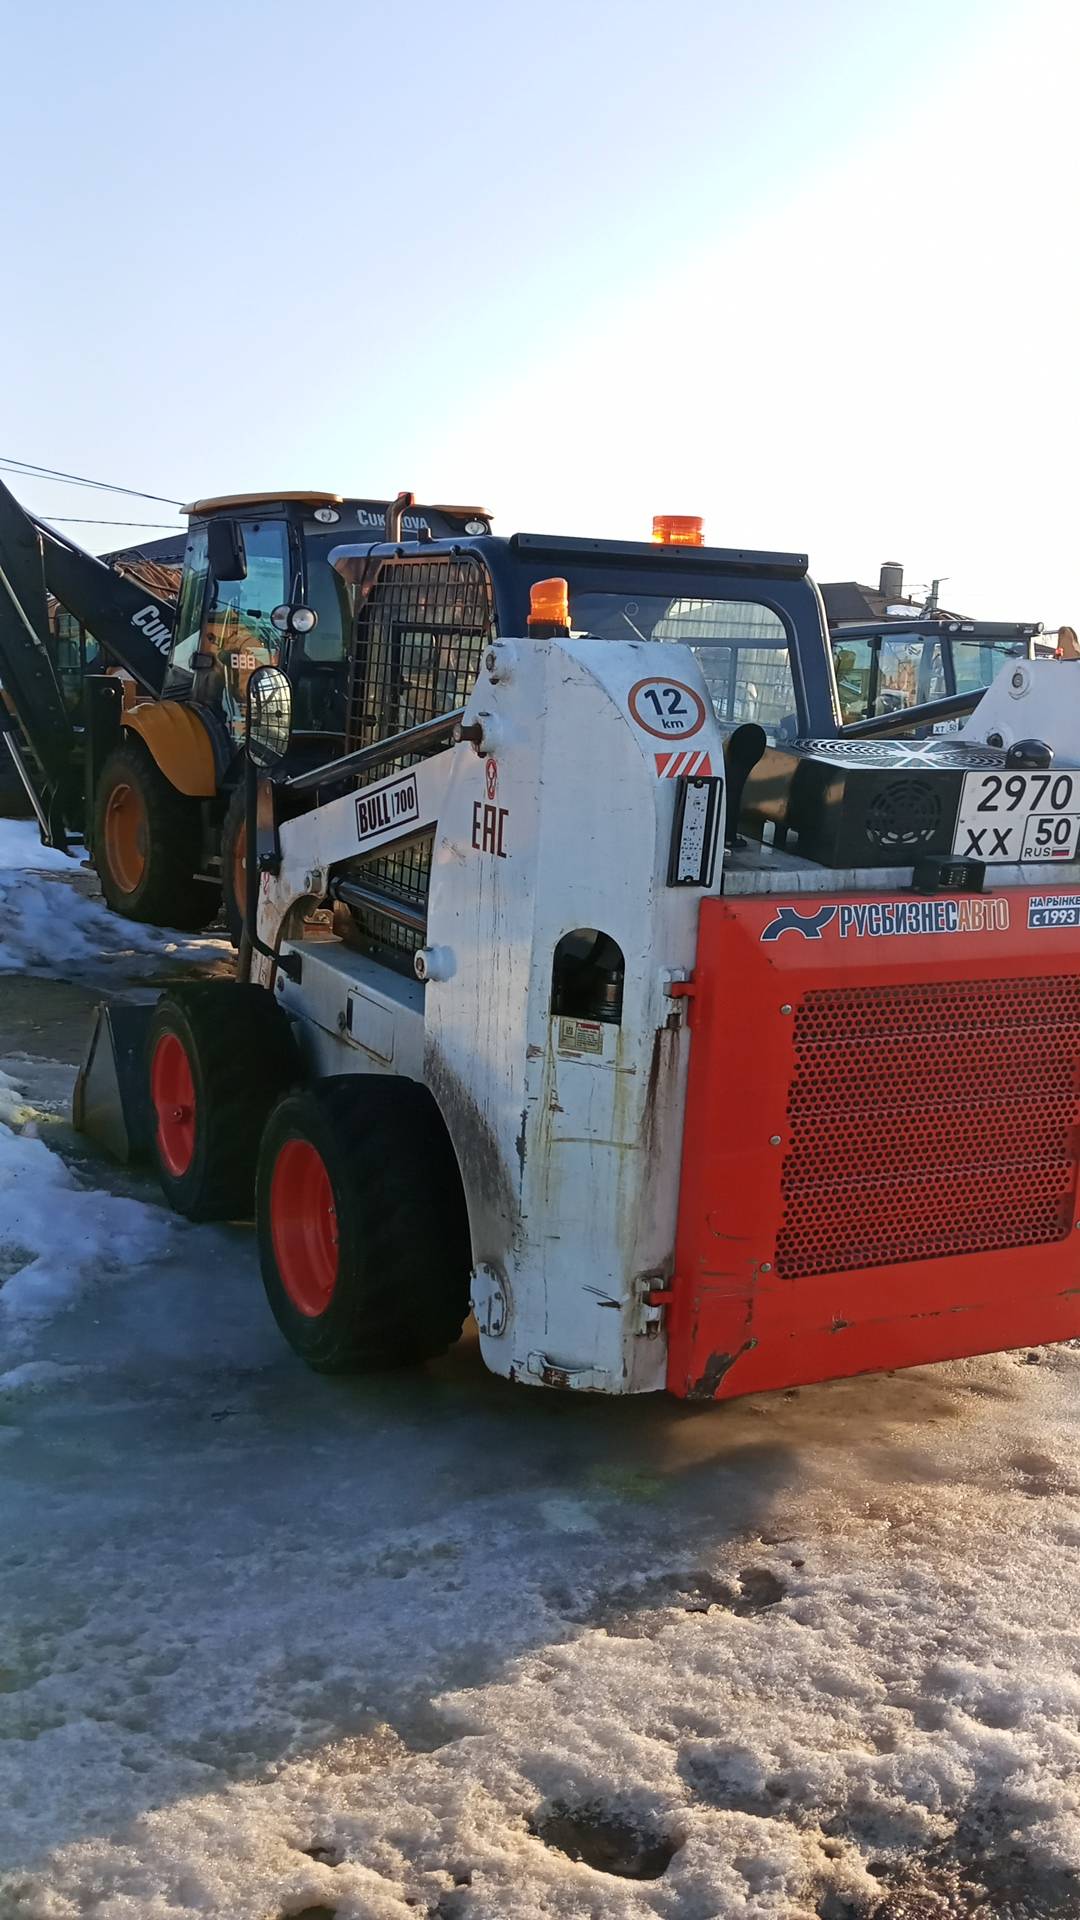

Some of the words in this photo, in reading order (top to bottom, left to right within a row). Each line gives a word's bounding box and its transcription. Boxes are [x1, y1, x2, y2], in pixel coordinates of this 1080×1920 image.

[643, 688, 688, 716] 12
[661, 718, 685, 729] km
[358, 792, 391, 834] BULL
[394, 785, 415, 815] 700
[977, 774, 1073, 812] 2970
[471, 801, 510, 859] EAC
[962, 828, 1014, 857] XX
[1035, 818, 1072, 846] 50
[1024, 847, 1051, 857] RUS
[839, 898, 1009, 938] РУСБИЗНЕСАВТО
[1030, 897, 1044, 908] НА
[1042, 909, 1076, 925] 1993
